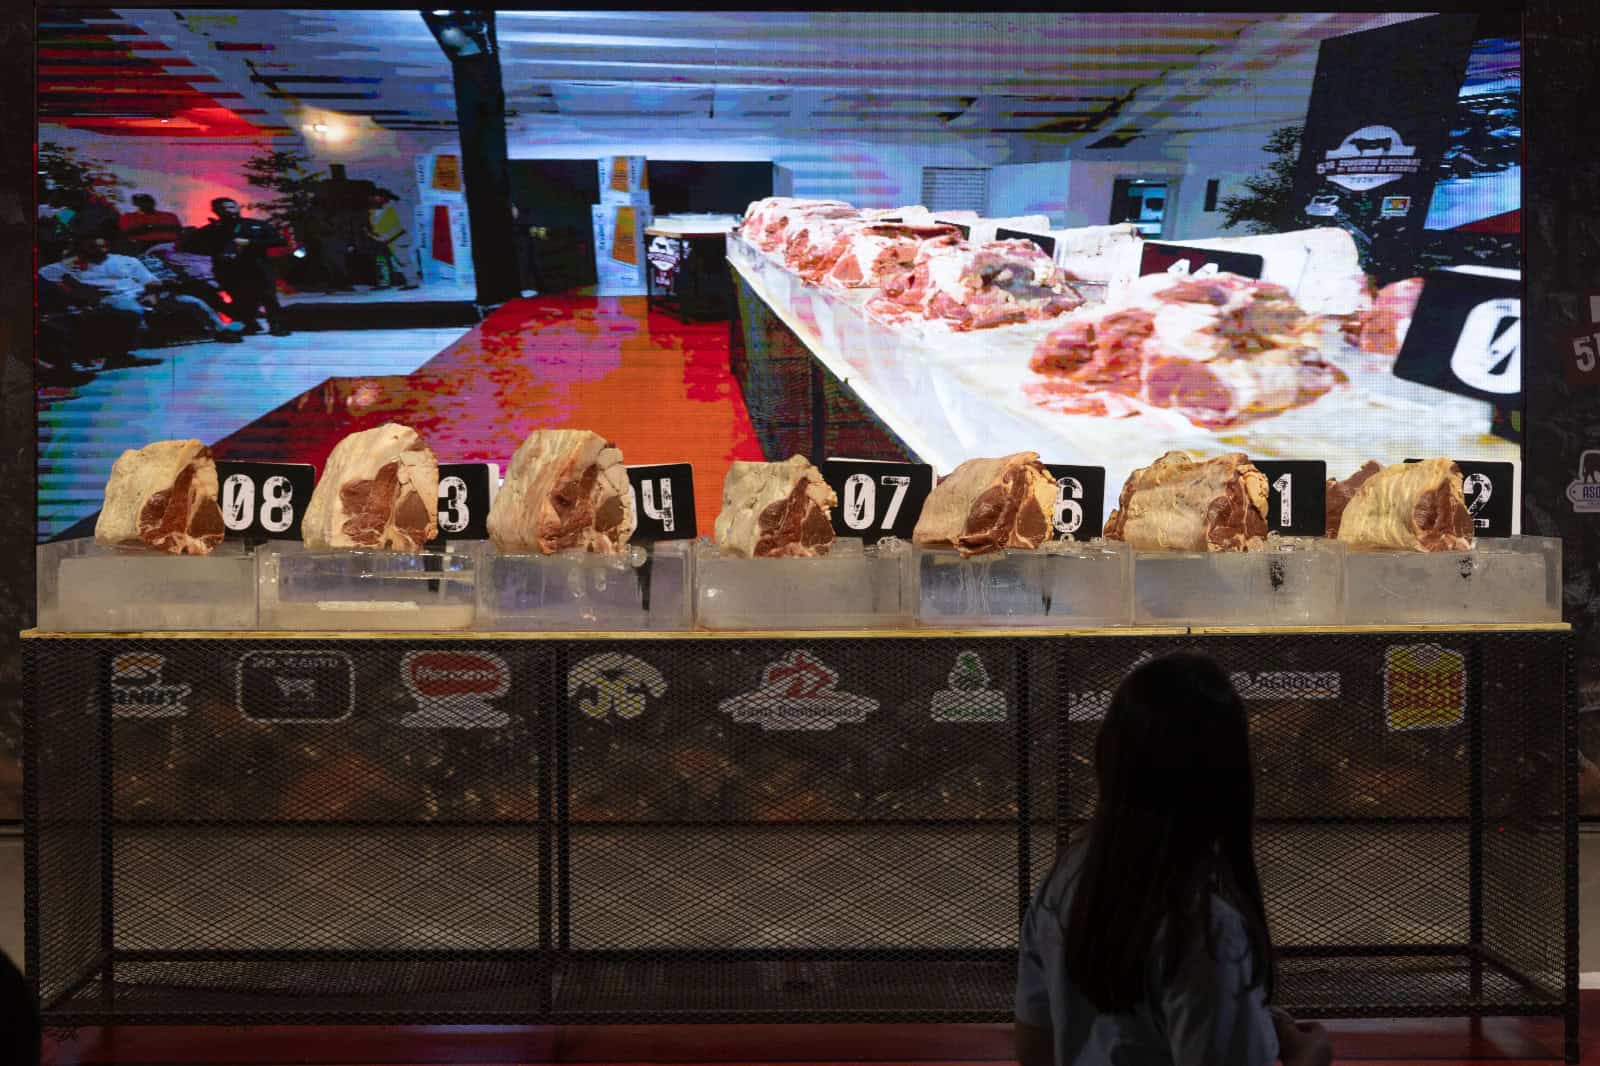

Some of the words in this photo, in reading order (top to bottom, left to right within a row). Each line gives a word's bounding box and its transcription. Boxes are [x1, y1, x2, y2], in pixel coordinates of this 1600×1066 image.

[222, 474, 294, 532] 08
[843, 473, 911, 530] 07
[1463, 473, 1493, 528] 2
